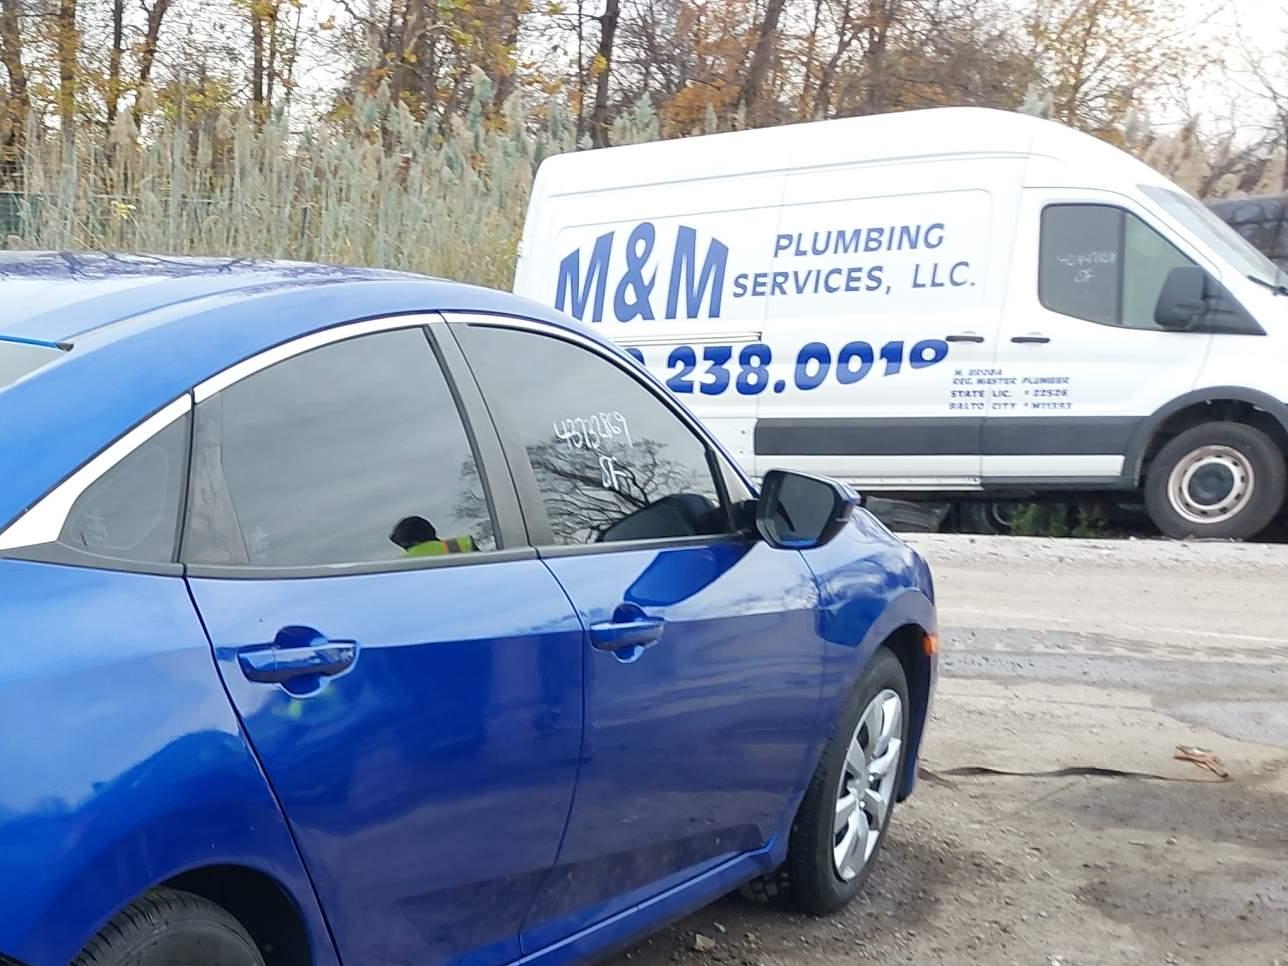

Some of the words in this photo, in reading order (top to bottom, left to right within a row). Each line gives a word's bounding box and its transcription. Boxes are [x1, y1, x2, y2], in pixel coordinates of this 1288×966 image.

[773, 223, 945, 258] PLUMBING
[554, 222, 729, 323] M&M
[732, 265, 892, 298] SERVICES,
[911, 261, 976, 289] LLC.
[624, 339, 949, 396] 238.0010
[950, 389, 985, 398] STATE
